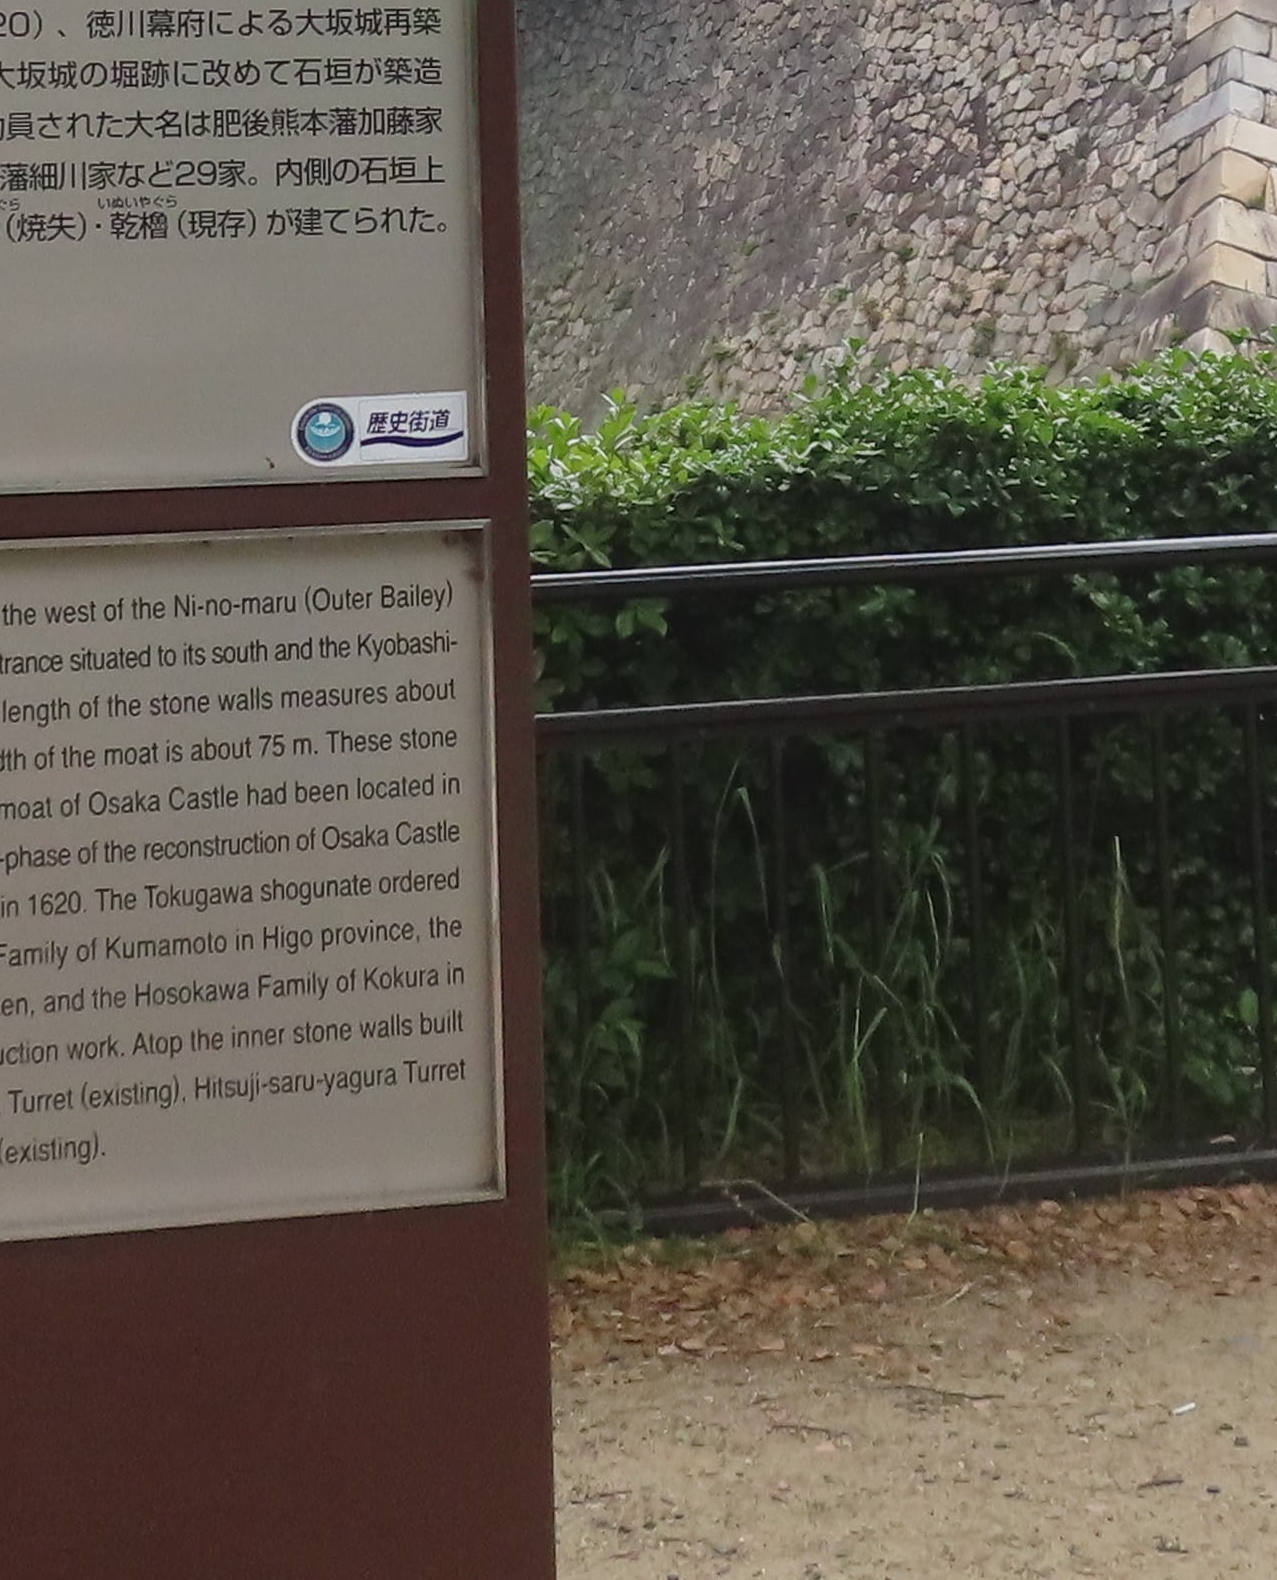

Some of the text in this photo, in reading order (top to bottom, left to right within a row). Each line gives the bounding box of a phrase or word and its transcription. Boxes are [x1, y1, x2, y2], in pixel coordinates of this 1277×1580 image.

[366, 408, 451, 435] 歴史街道
[1, 602, 37, 627] the
[44, 600, 97, 625] west
[130, 596, 166, 621] the
[173, 593, 297, 619] Ni-no-maru
[304, 585, 374, 615] (Outer
[380, 579, 453, 613] Bailey)
[69, 643, 152, 672] situated
[182, 641, 207, 667] its
[211, 638, 268, 665] south
[274, 636, 313, 662] and
[318, 634, 351, 659] the
[357, 629, 458, 663] Kyobashi-
[2, 696, 71, 729] length
[106, 693, 142, 718] the
[149, 693, 211, 717] stone
[217, 685, 274, 712] walls
[280, 685, 389, 709] measures
[394, 677, 457, 704] about
[60, 744, 96, 769] the
[103, 742, 160, 767] moat
[165, 739, 184, 764] is
[190, 736, 252, 762] about
[258, 733, 286, 758] 75
[292, 737, 319, 757] m.
[325, 729, 393, 754] These
[399, 727, 458, 751] stone
[88, 789, 161, 816] Osaka
[168, 783, 239, 812] Castle
[246, 780, 287, 807] had
[294, 779, 349, 804] been
[356, 772, 435, 801] located
[103, 839, 137, 864] the
[143, 830, 290, 862] reconstruction
[321, 824, 390, 851] Osaka
[395, 819, 461, 846] Castle
[27, 889, 87, 917] 1620.
[93, 887, 138, 913] The
[143, 883, 254, 913] Tokugawa
[260, 873, 372, 906] shogunate
[378, 865, 460, 895] ordered
[105, 931, 228, 960] Kumamoto
[262, 924, 314, 956] Higo
[320, 918, 420, 953] province,
[428, 915, 463, 939] the
[43, 987, 85, 1014] and
[91, 985, 127, 1011] the
[134, 979, 251, 1008] Hosokawa
[257, 971, 330, 1001] Family
[363, 965, 440, 992] Kokura
[66, 1033, 125, 1061] work.
[131, 1031, 183, 1060] Atop
[190, 1027, 224, 1052] the
[231, 1025, 286, 1049] inner
[292, 1020, 352, 1045] stone
[358, 1012, 414, 1040] walls
[419, 1008, 464, 1036] built
[7, 1088, 75, 1114] Turret
[194, 1067, 398, 1103] Hitsuji-saru-yagura
[402, 1058, 466, 1085] Turret
